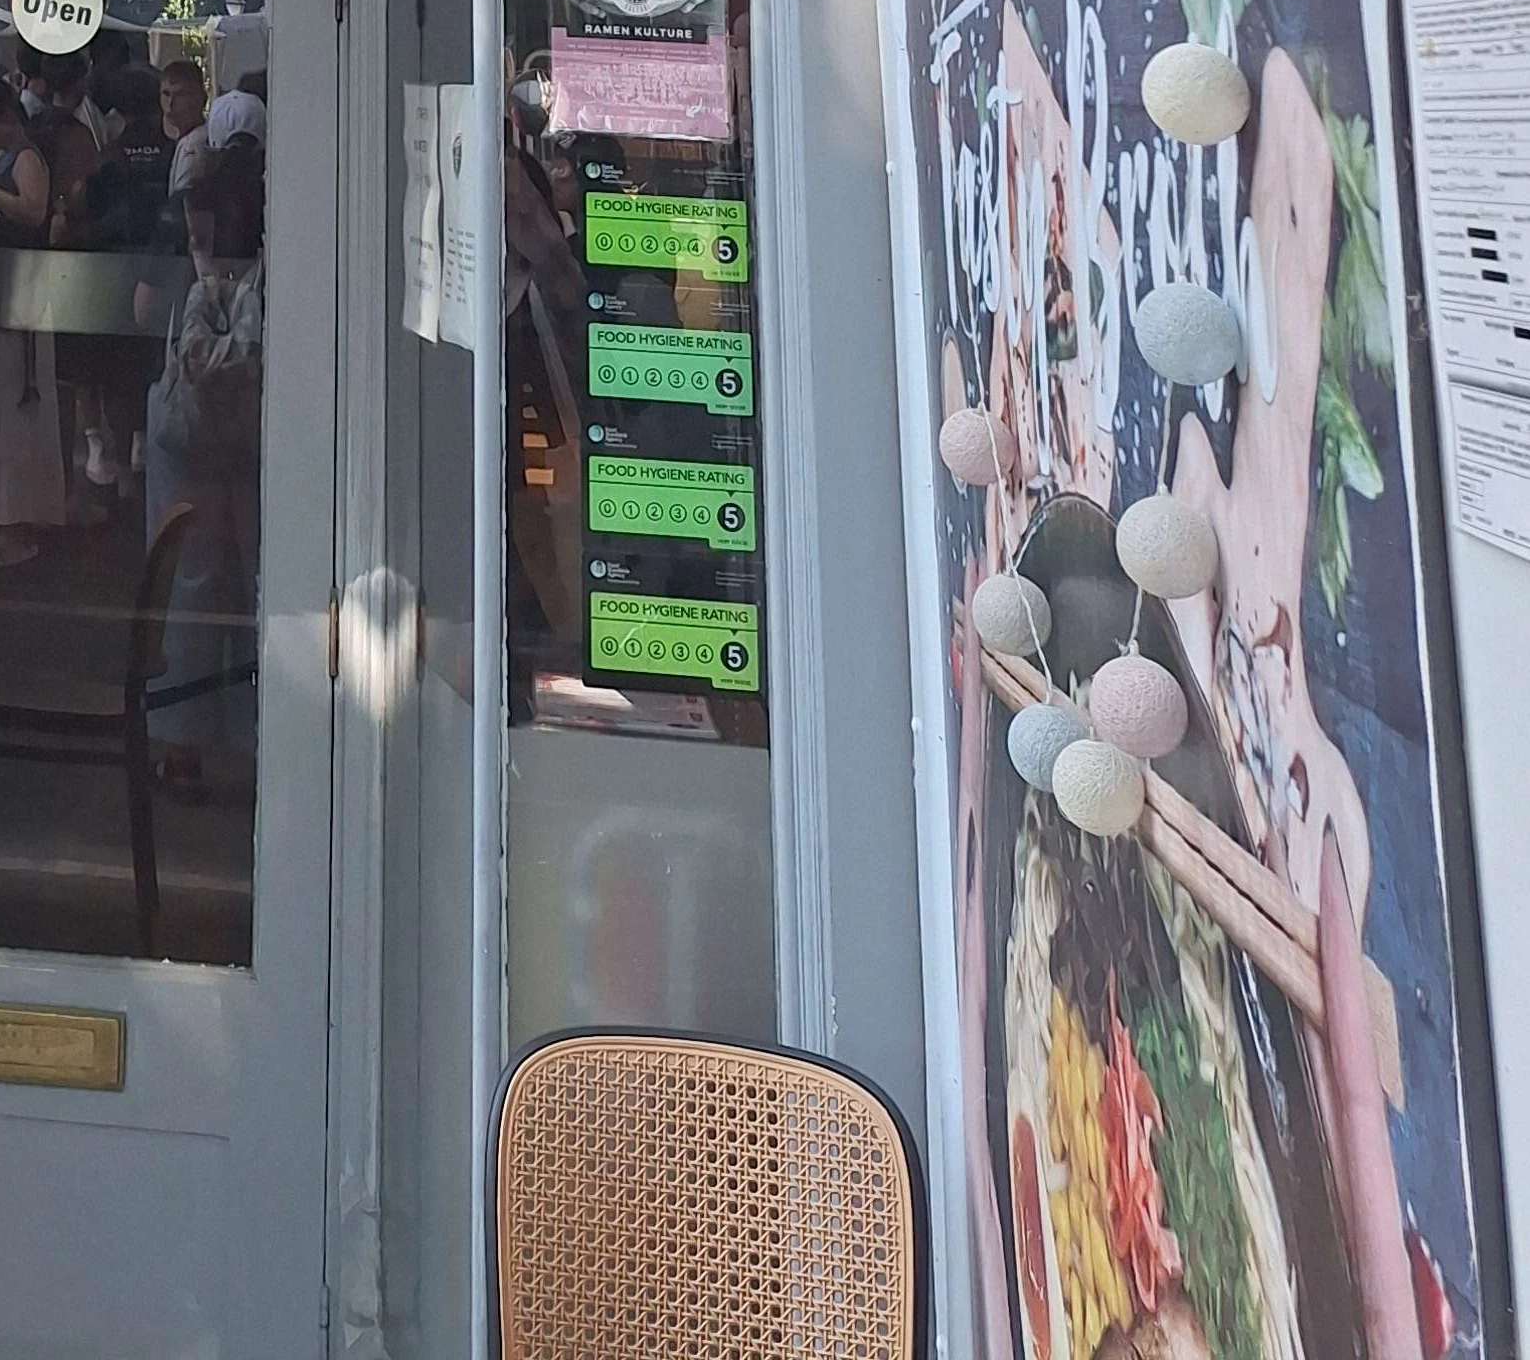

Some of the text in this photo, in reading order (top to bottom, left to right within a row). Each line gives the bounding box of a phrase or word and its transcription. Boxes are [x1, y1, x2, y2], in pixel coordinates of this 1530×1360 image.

[584, 24, 693, 39] RAMEN KULTURE
[593, 199, 738, 219] FOOD HYGIENE RATING
[719, 240, 732, 260] 5
[597, 331, 743, 351] FOOD HYGIENE RATING
[722, 372, 736, 394] 5
[598, 464, 745, 485] FOOD HYGIENE RATING
[724, 506, 738, 529] 5
[600, 600, 748, 623] FOOD HYGIENE RATING
[727, 645, 742, 667] 5
